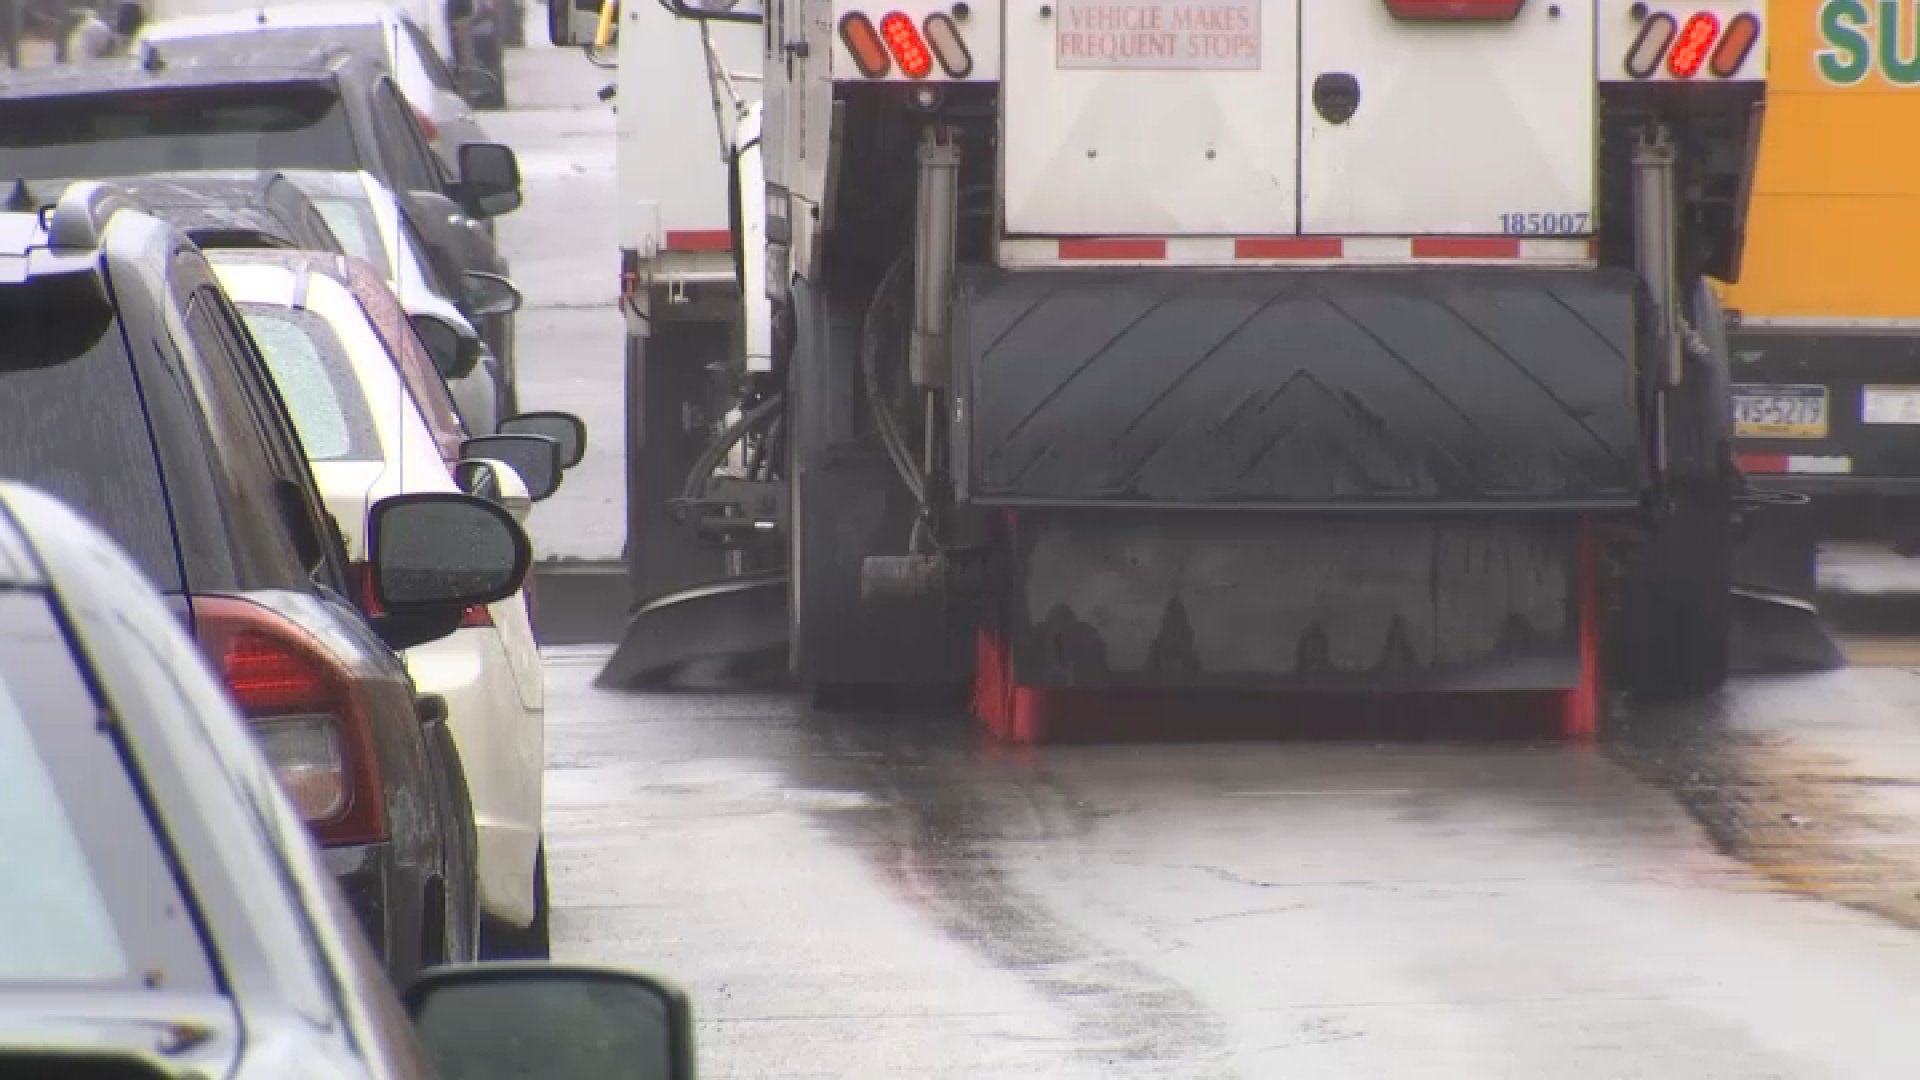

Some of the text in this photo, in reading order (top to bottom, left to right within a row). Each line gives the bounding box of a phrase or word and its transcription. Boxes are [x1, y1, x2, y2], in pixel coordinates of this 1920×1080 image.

[1070, 6, 1249, 30] VEHICLE MAKES
[1060, 33, 1257, 61] FREQUENT STOPS
[1499, 212, 1589, 234] 185007
[1732, 397, 1822, 423] VS-5279
